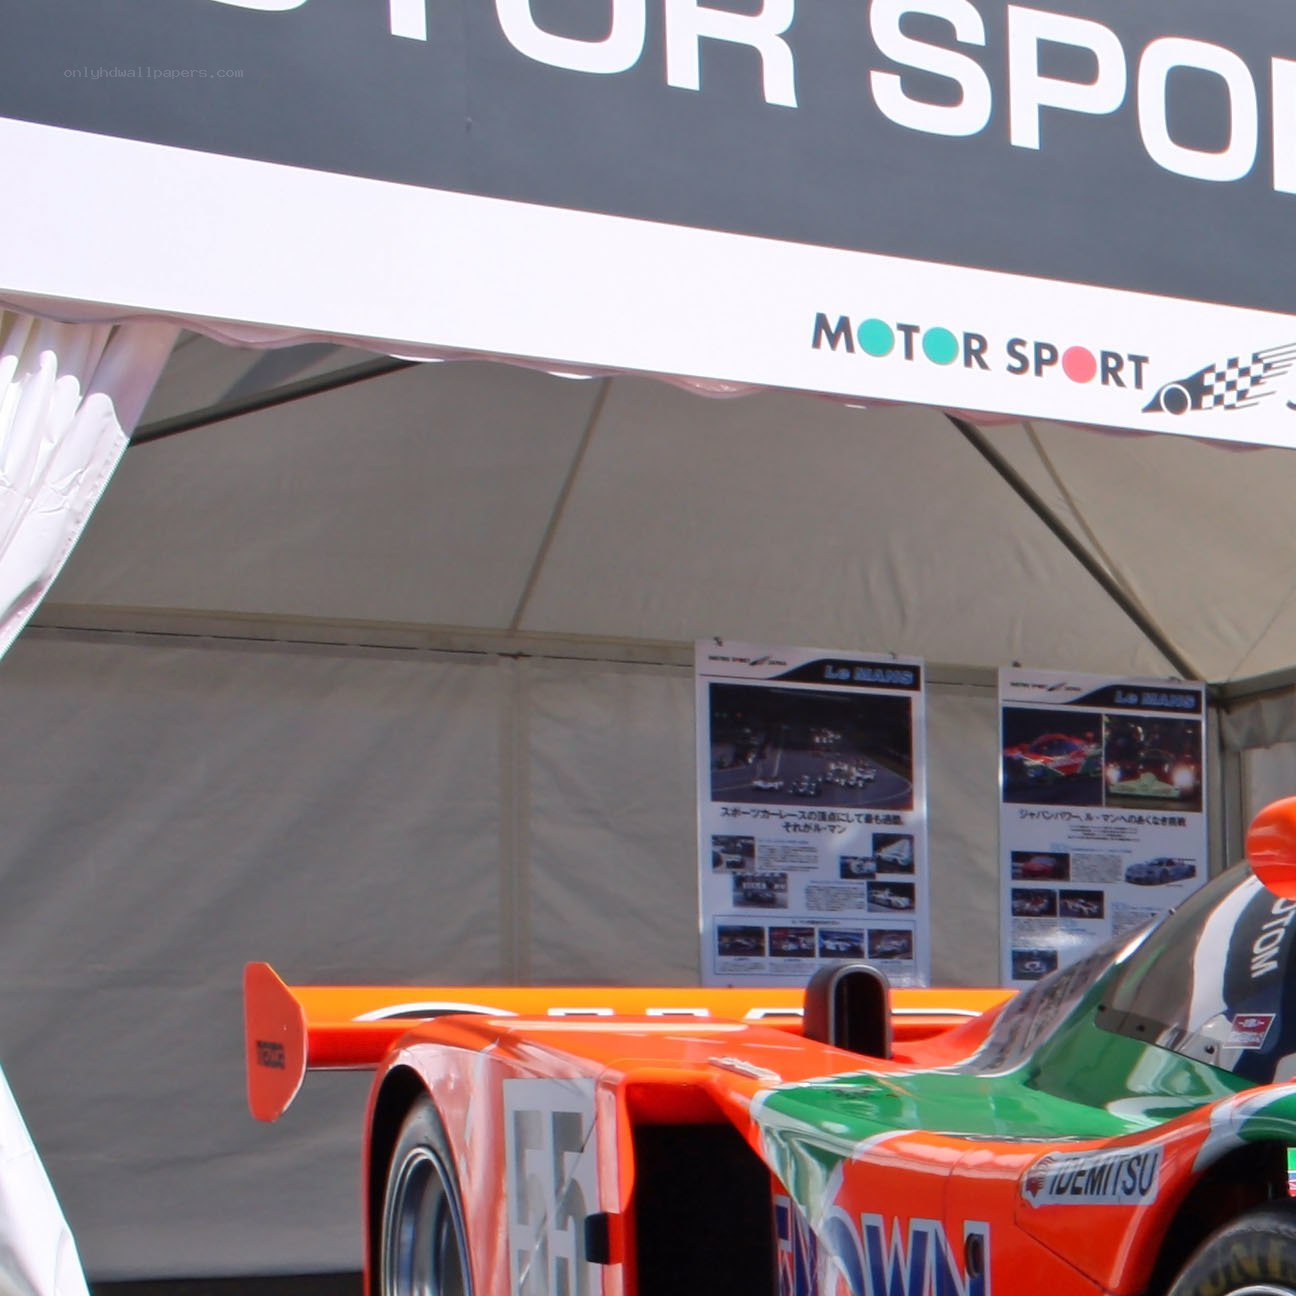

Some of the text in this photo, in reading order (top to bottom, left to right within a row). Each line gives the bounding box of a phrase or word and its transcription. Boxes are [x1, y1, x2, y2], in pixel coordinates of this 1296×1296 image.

[811, 312, 990, 371] MOTOR
[1005, 337, 1150, 392] SPORT
[1047, 1152, 1158, 1198] IDEMITSU
